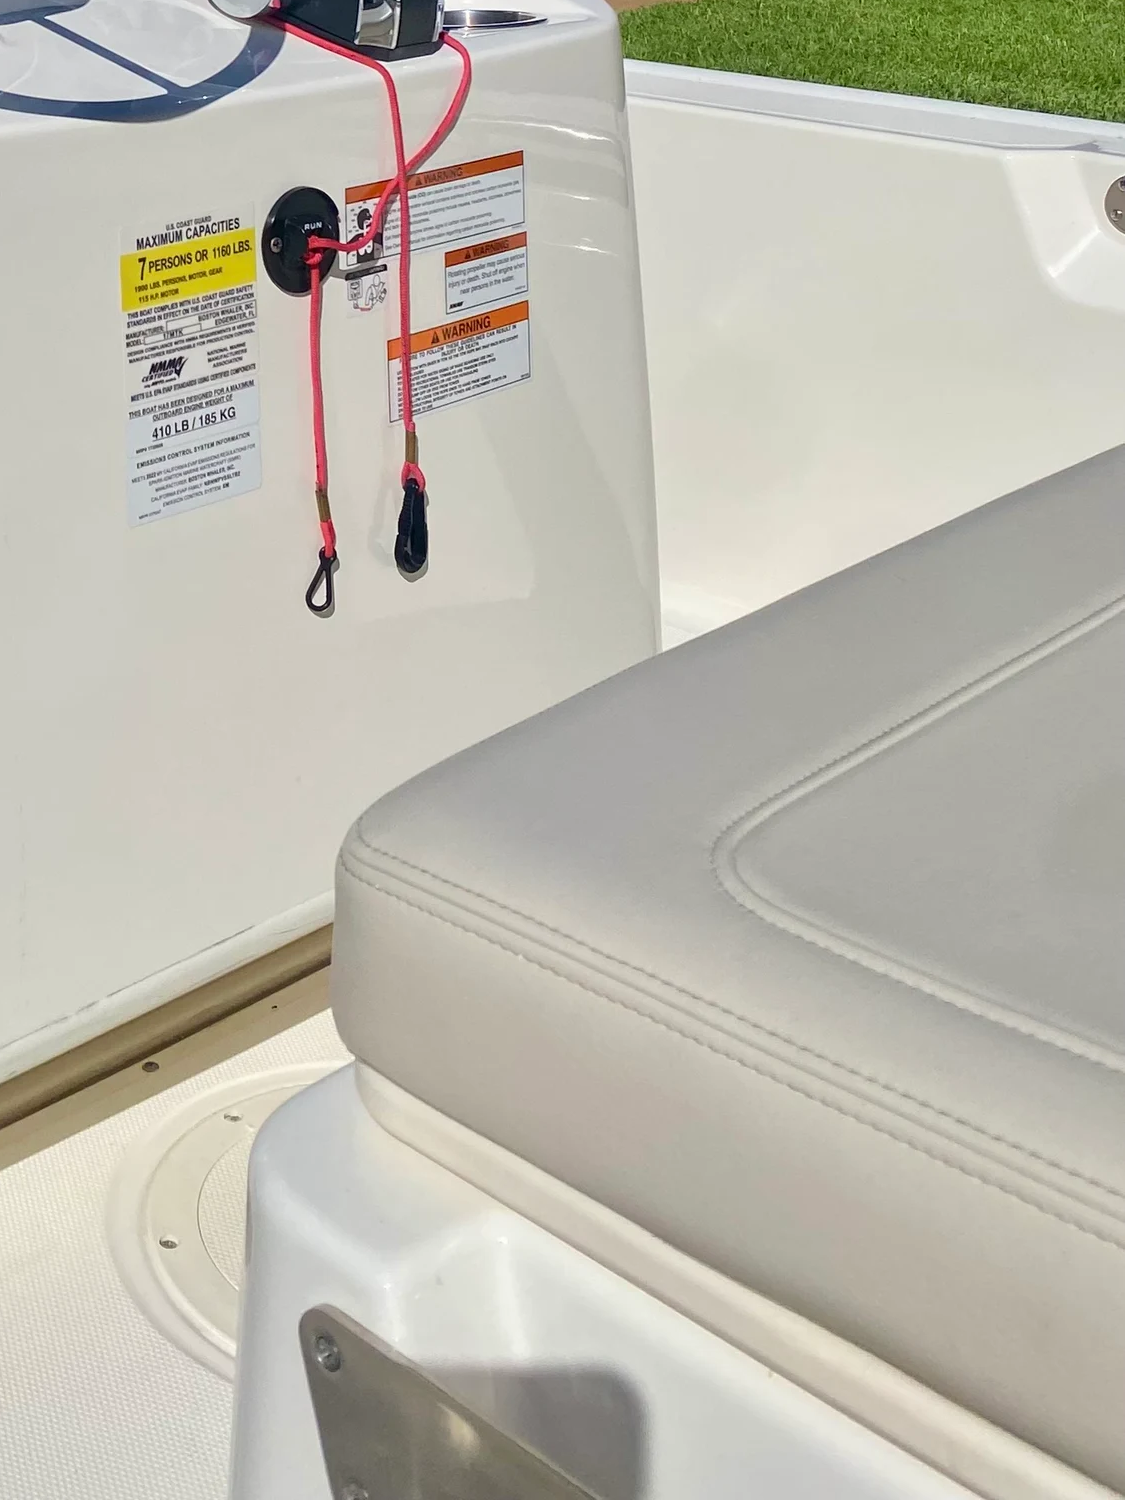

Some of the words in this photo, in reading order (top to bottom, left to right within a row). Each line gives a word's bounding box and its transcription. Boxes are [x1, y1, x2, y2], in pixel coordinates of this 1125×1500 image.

[425, 168, 463, 184] WARNING
[176, 220, 193, 229] COAST
[195, 216, 212, 225] GUARD
[304, 221, 323, 231] RUN
[137, 229, 183, 251] MAXIMUM
[186, 217, 240, 240] CAPACITIES
[473, 240, 509, 257] WARNING
[138, 257, 147, 281] 7
[149, 253, 192, 274] PERSONS
[195, 249, 209, 263] OR
[213, 244, 231, 259] 1160
[233, 239, 253, 254] LBS.
[209, 267, 223, 275] GEAR
[499, 266, 513, 275] engine
[161, 289, 179, 298] MOTOR
[471, 283, 489, 293] persons
[128, 312, 139, 320] THIS
[140, 309, 153, 317] BOAT
[154, 302, 178, 313] COMPLIES
[180, 299, 191, 307] WITH
[202, 293, 218, 302] COAST
[219, 288, 235, 297] GUARD
[237, 284, 253, 293] SAFETY
[127, 316, 156, 329] STANDARDS
[164, 310, 182, 320] EFFECT
[201, 302, 213, 310] DATE
[221, 292, 254, 305] CERTIFICATION
[198, 312, 220, 322] BOSTON
[443, 315, 491, 340] WARNING
[427, 347, 444, 355] FOLLOW
[446, 342, 460, 350] THESE
[461, 334, 485, 345] GUIDELINES
[496, 326, 511, 334] RESULT
[442, 348, 457, 356] INJURY
[466, 341, 479, 349] DEATH
[142, 369, 174, 383] CERTIFIED
[129, 410, 141, 419] THIS
[143, 406, 157, 415] BOAT
[158, 403, 169, 411] HAS
[170, 398, 185, 408] BEEN
[187, 391, 213, 403] DESIGNED
[214, 387, 225, 396] FOR
[231, 379, 254, 391] MAXIMUM
[153, 408, 183, 422] OUTBOARD
[184, 402, 204, 413] ENGINE
[205, 396, 226, 407] WEIGHT
[152, 424, 171, 440] 410
[175, 419, 189, 434] LB
[192, 417, 196, 429] /
[200, 412, 217, 427] 185
[220, 406, 236, 421] KG
[137, 456, 166, 469] EMISSIONS
[167, 448, 193, 460] CONTROL
[194, 442, 214, 452] SYSTEM
[216, 432, 250, 446] INFORMATION
[189, 473, 206, 482] BOSTON
